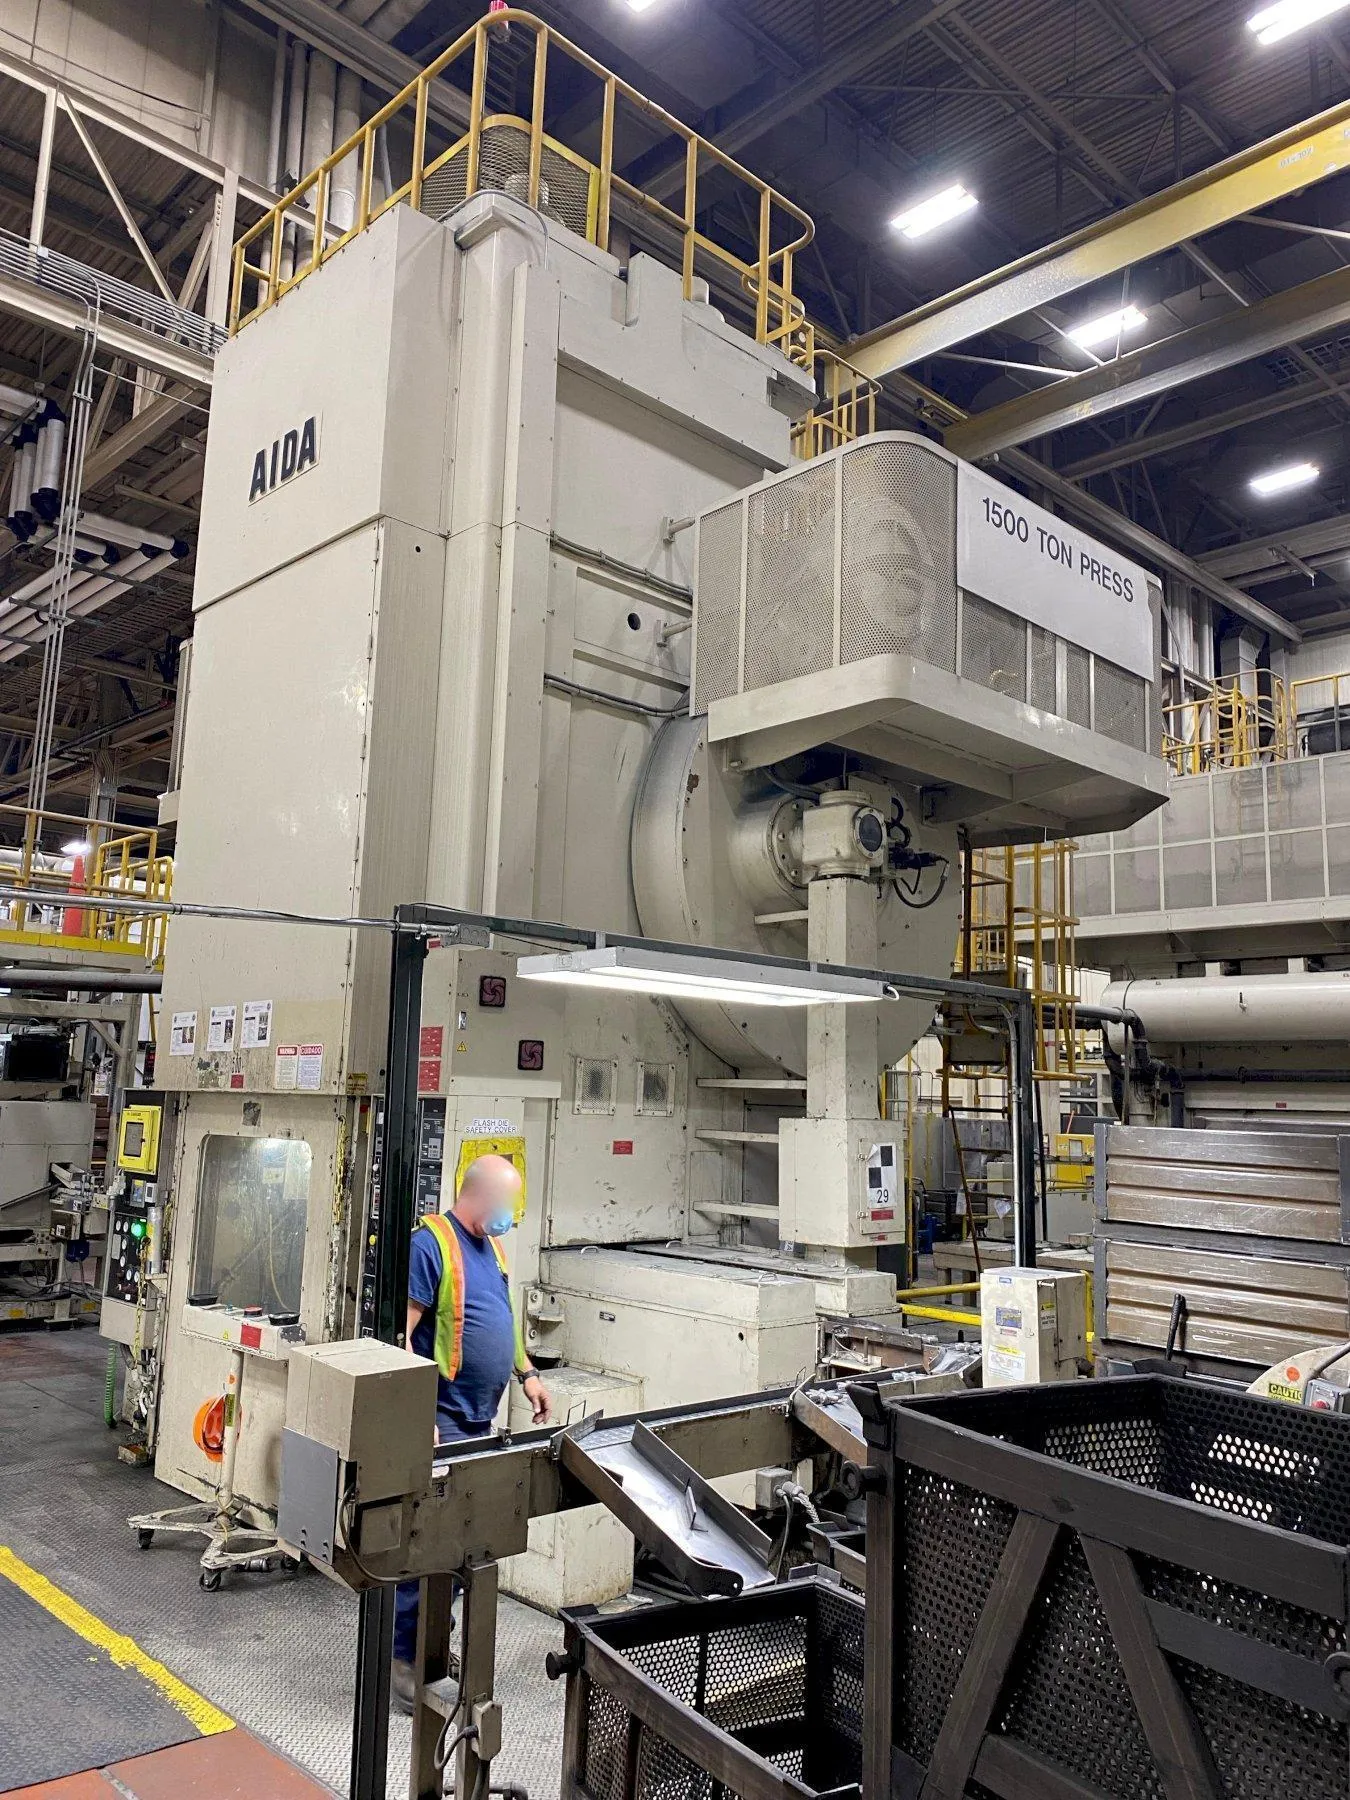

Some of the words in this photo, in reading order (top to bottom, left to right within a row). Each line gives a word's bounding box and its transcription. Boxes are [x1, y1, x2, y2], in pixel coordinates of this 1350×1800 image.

[249, 415, 316, 502] AIDA
[983, 497, 1029, 543] 1500
[1036, 526, 1073, 569] TON
[1080, 552, 1134, 603] PRESS
[465, 1126, 492, 1134] SAFETY
[494, 1126, 517, 1134] COVER
[473, 1119, 496, 1127] FLASH
[498, 1119, 509, 1127] DIE
[876, 1189, 889, 1204] 29
[1270, 1384, 1303, 1400] CAUTIO
